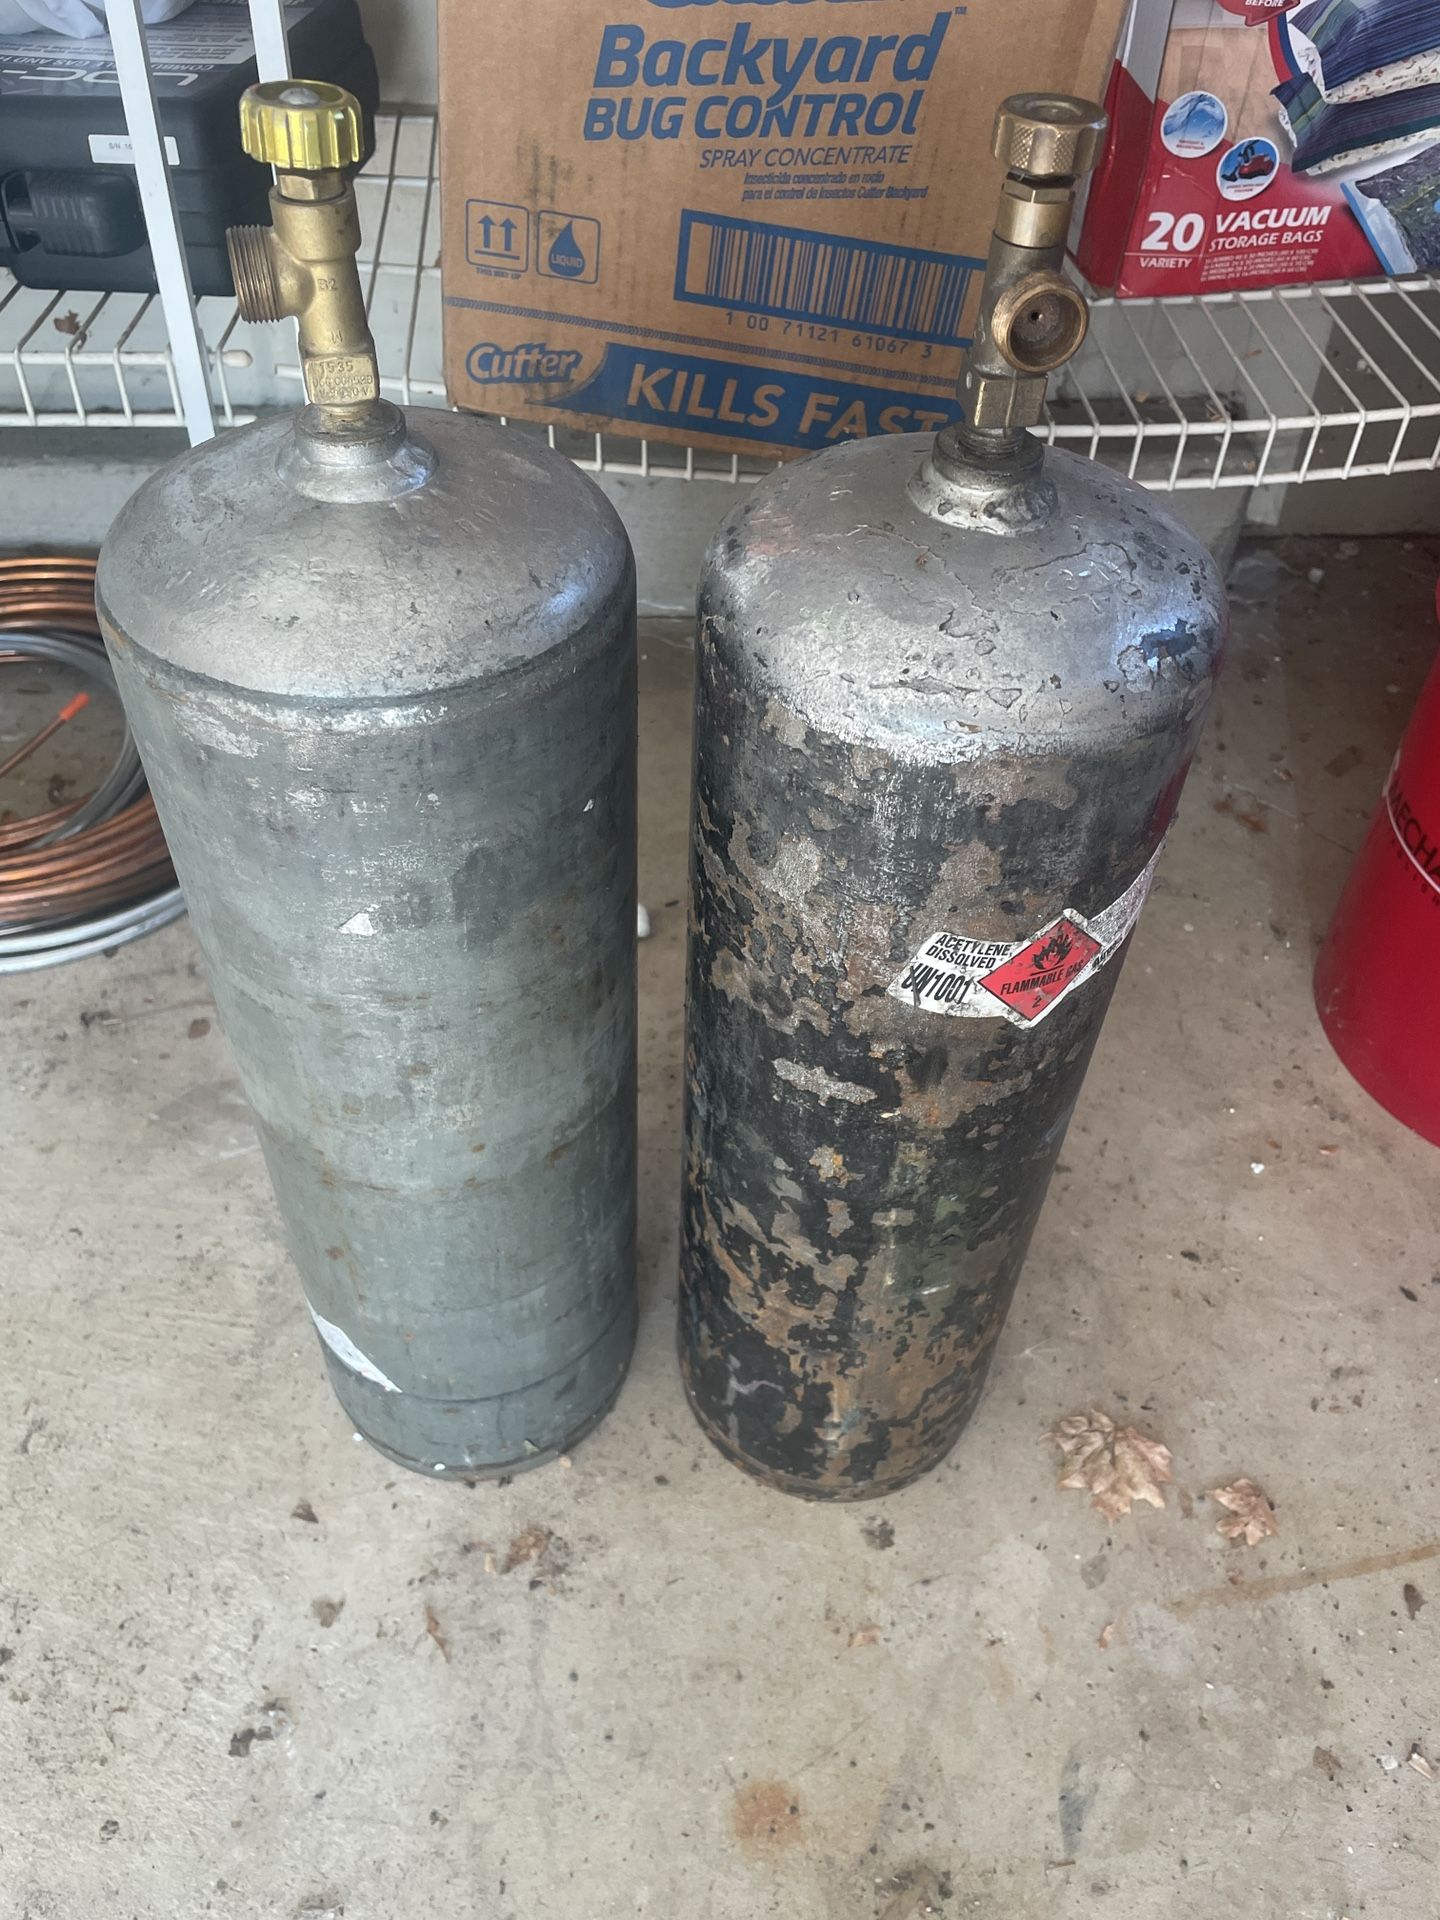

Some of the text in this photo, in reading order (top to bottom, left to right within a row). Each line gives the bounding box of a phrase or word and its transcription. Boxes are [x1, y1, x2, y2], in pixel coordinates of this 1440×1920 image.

[593, 11, 953, 105] Backyard
[583, 89, 926, 141] BUG CONTROL
[699, 144, 913, 168] SPRAY CONCENTRATE
[1140, 211, 1205, 252] 20
[1216, 205, 1332, 233] VACUUM
[1209, 230, 1324, 252] STORAGE BAGS
[551, 253, 584, 268] LIQUID
[1139, 257, 1192, 268] VARIETY
[725, 311, 933, 359] 1 00 71121 61067 3
[468, 342, 578, 382] Cutter
[626, 363, 949, 440] KILLS FAST
[925, 944, 997, 970] DISSOLVED
[901, 961, 974, 1005] UN1001
[1000, 958, 1085, 996] FLAMMABLE GAS
[1032, 996, 1043, 1009] 2
